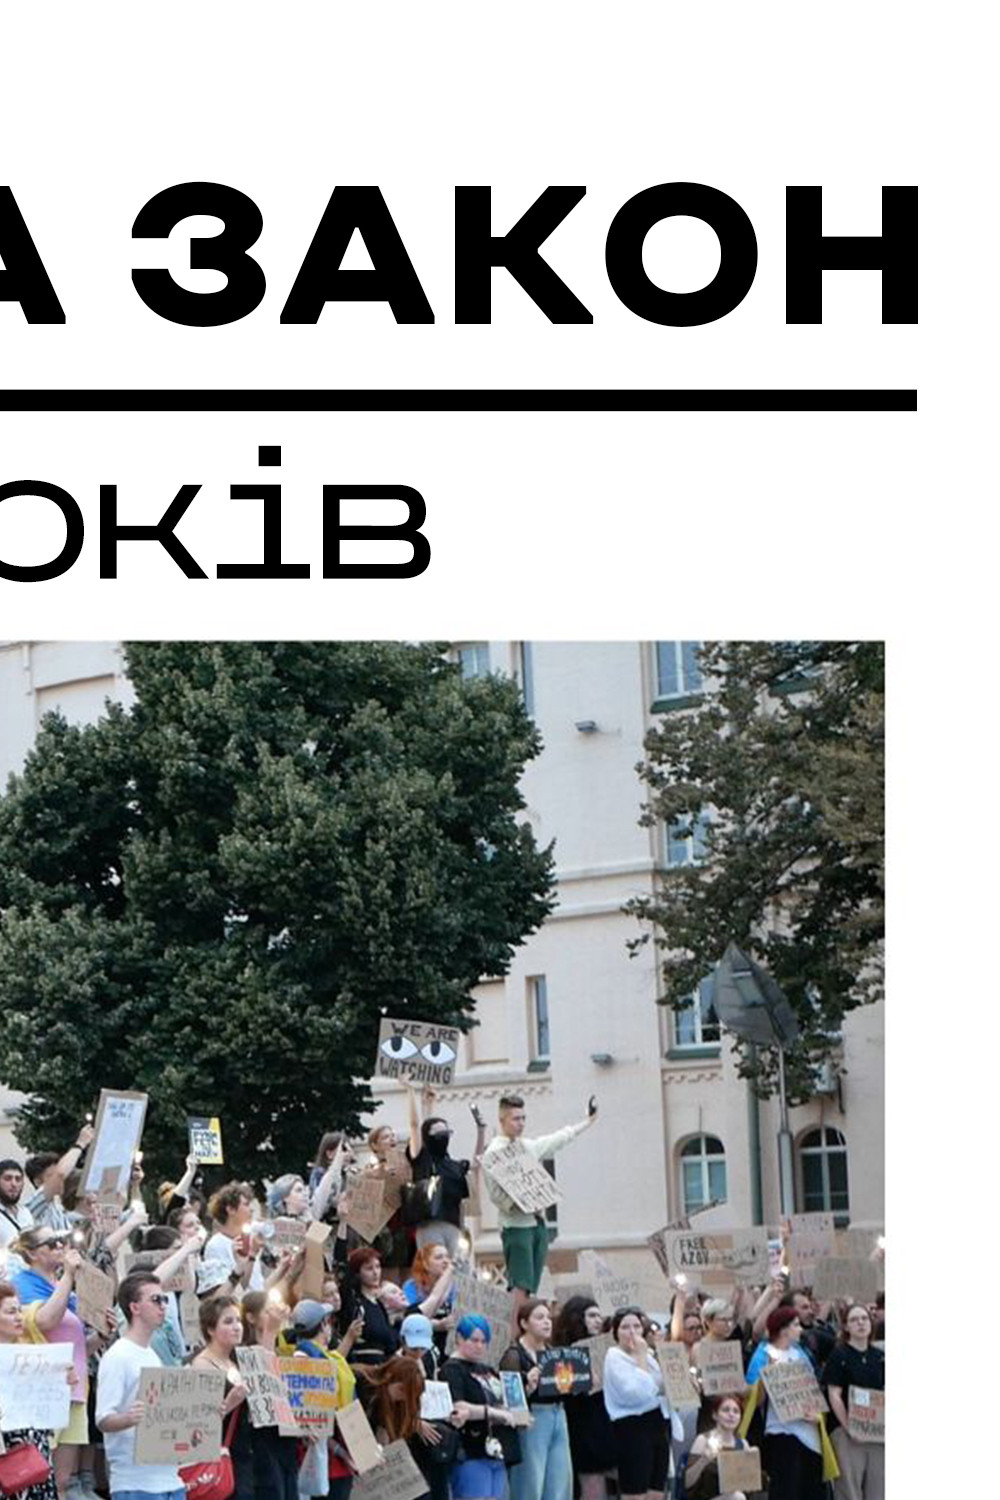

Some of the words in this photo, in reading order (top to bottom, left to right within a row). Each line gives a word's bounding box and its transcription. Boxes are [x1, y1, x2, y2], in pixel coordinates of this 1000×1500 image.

[391, 1022, 422, 1037] WE
[426, 1027, 458, 1041] ARE
[380, 1057, 452, 1085] WATCHING
[679, 1237, 706, 1250] FREE
[680, 1251, 710, 1266] AZOV
